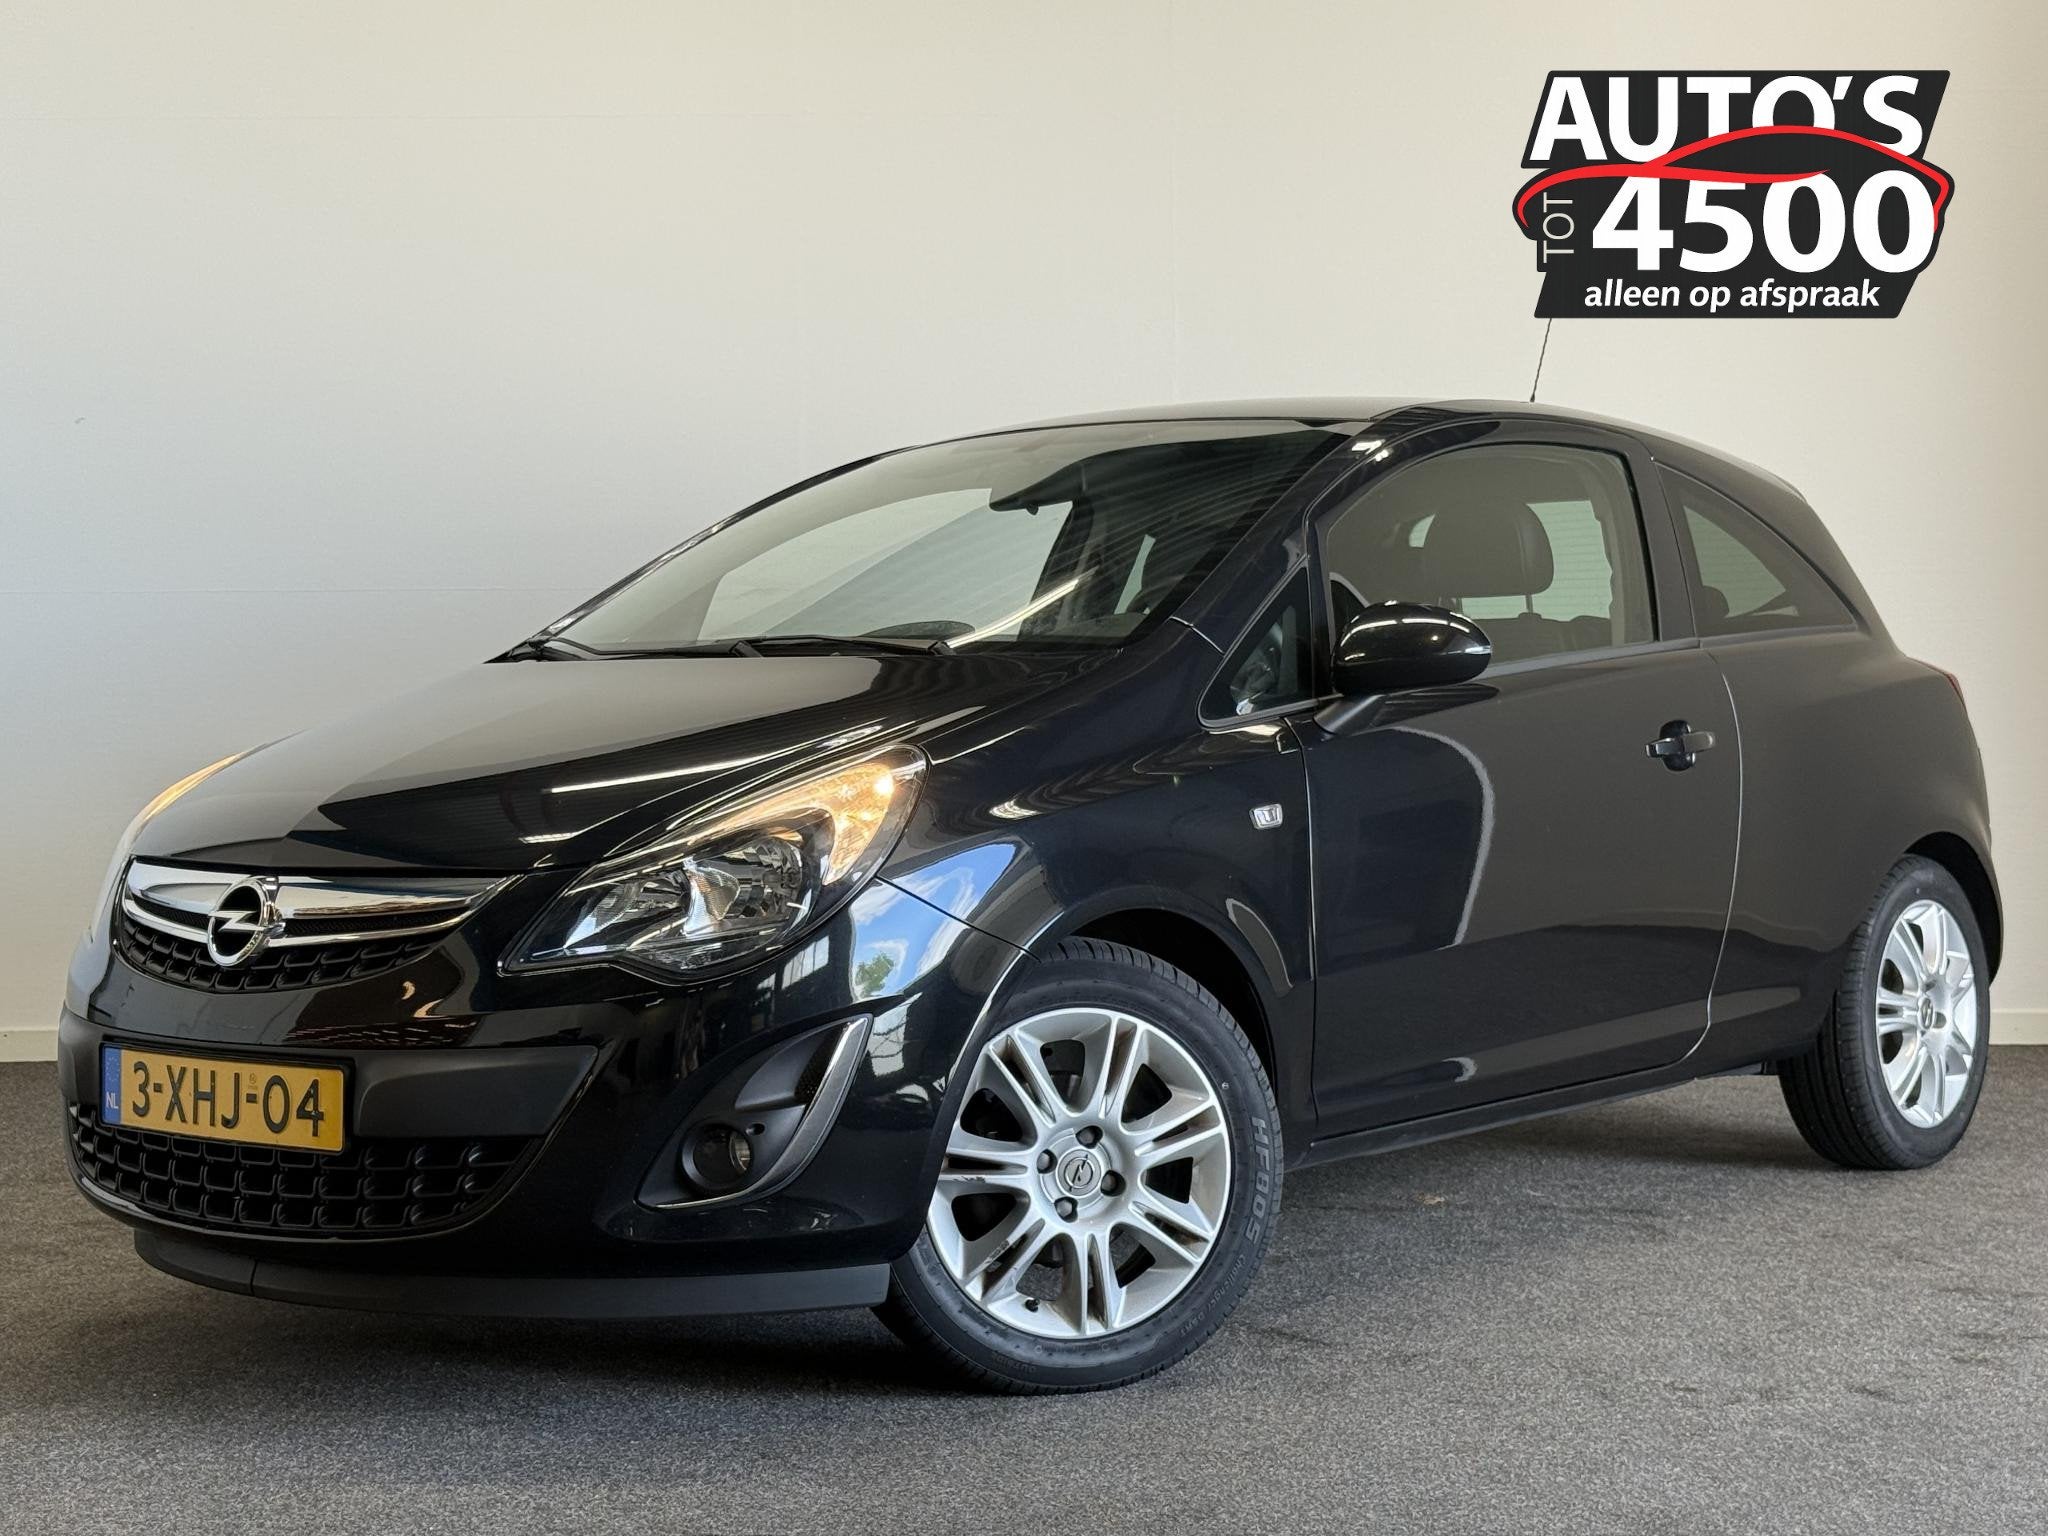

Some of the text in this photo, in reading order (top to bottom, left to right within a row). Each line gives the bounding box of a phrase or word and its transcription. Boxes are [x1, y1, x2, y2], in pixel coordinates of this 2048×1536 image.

[105, 1091, 119, 1110] NL
[132, 1061, 324, 1137] 3-XHJ-04
[1245, 1117, 1270, 1244] HF805
